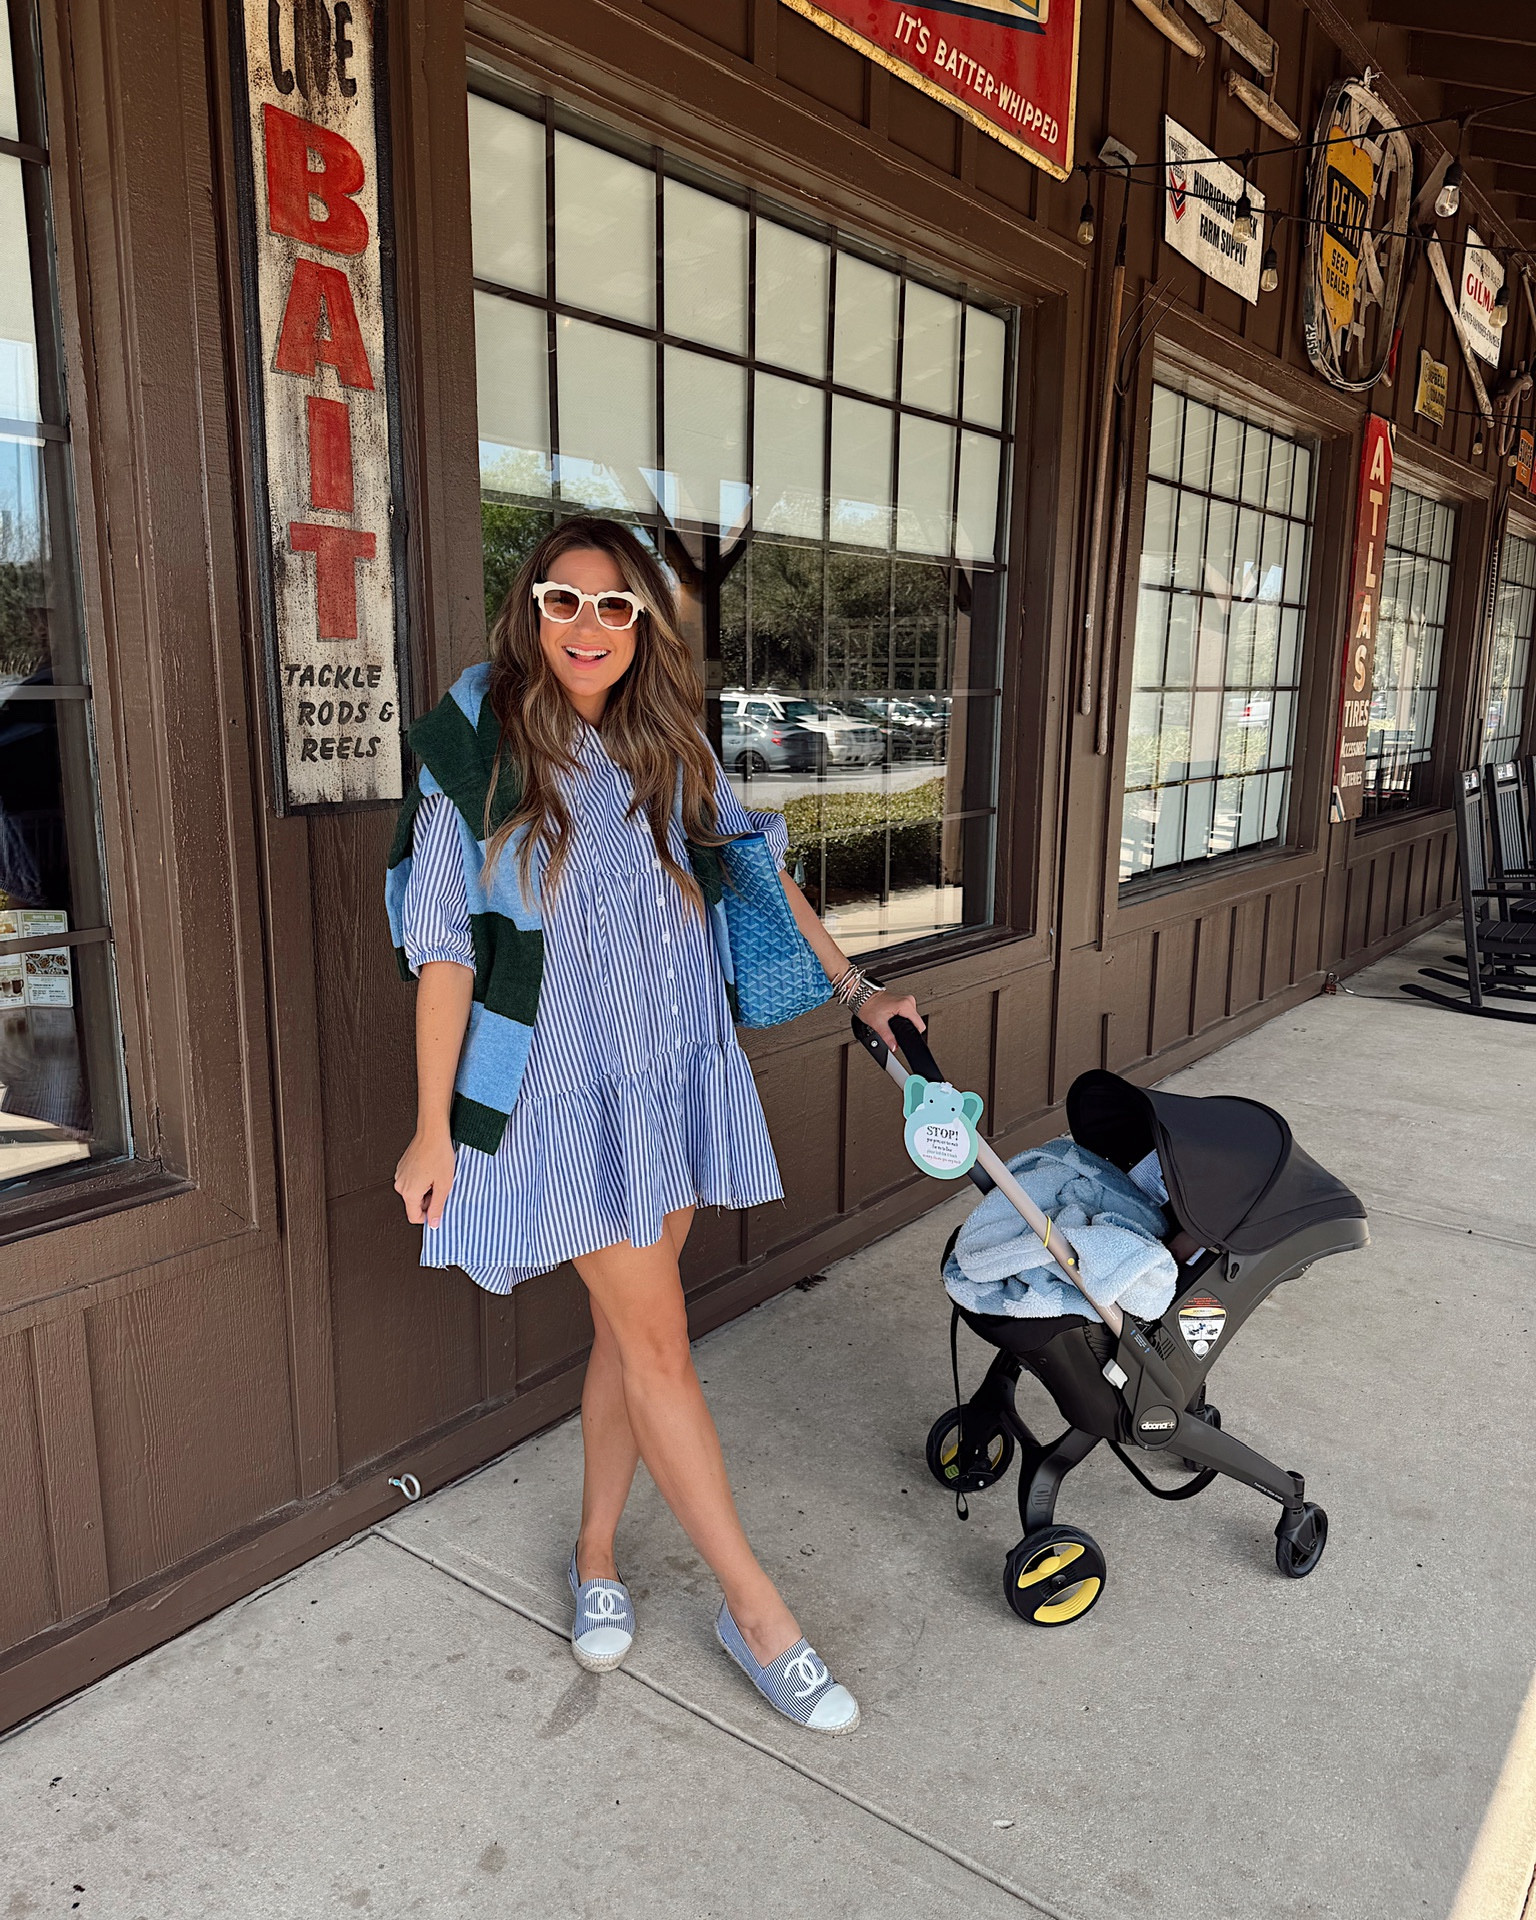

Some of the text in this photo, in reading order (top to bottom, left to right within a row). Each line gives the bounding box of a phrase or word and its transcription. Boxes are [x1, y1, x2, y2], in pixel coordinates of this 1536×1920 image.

[895, 11, 1059, 145] IT'S BATTER-WHIPPED
[1330, 178, 1365, 250] RENK
[1200, 213, 1221, 249] FARM
[1220, 229, 1248, 268] SUPPLY
[1331, 248, 1350, 277] SEED
[1325, 265, 1350, 301] DEALER
[262, 102, 378, 642] BAIT
[1351, 436, 1386, 694] ATLAS
[284, 664, 382, 689] TACKLE
[298, 700, 395, 727] RODS &
[1344, 700, 1370, 728] TIRES
[301, 736, 382, 762] REELS
[926, 1126, 959, 1141] STOP!
